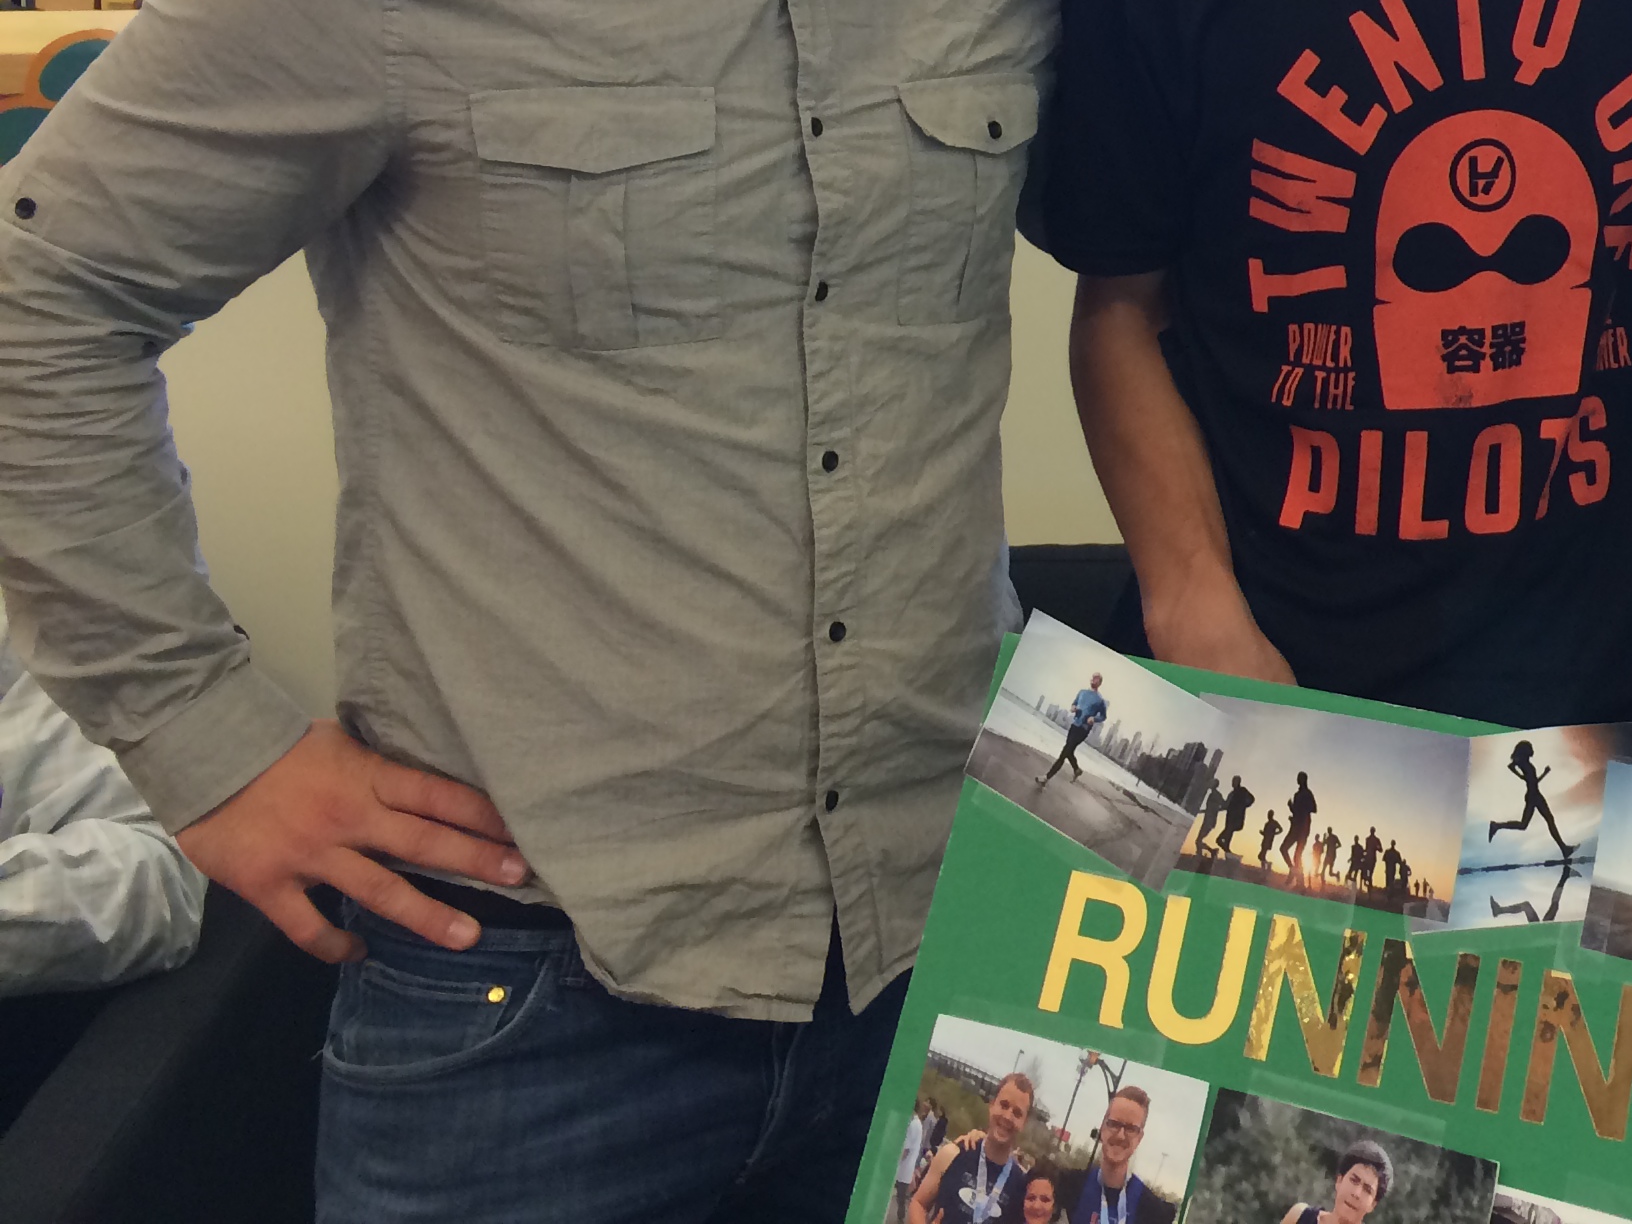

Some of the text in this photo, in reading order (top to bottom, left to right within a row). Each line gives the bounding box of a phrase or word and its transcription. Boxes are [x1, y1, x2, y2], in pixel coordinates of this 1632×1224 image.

[1288, 323, 1353, 367] POWER
[1440, 320, 1527, 374] 容器
[1271, 365, 1355, 410] TO THE
[1279, 395, 1611, 541] PILOTS
